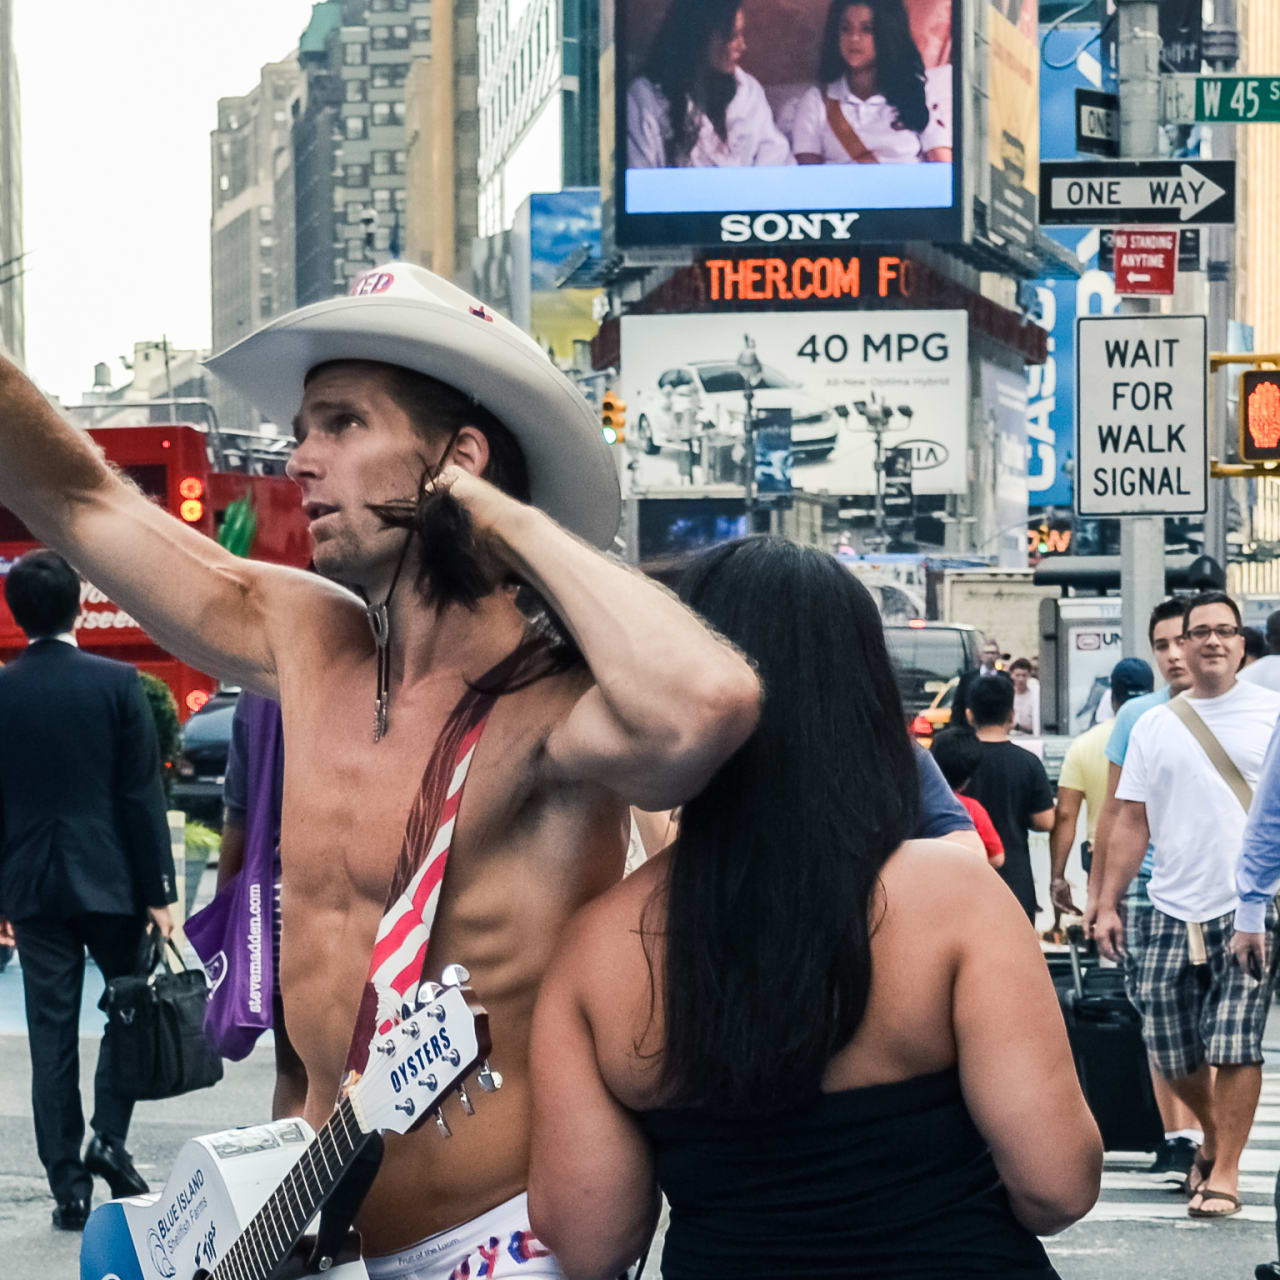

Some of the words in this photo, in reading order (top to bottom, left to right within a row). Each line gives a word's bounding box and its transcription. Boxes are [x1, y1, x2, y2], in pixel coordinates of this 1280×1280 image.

[1202, 80, 1222, 118] W
[1230, 80, 1260, 119] 45
[1066, 181, 1122, 205] ONE
[1149, 181, 1206, 205] WAY
[720, 212, 860, 243] SONY
[1129, 234, 1174, 250] STANDING
[1120, 253, 1165, 269] ANYTIME
[796, 333, 849, 364] 40
[863, 332, 949, 364] MPG
[1104, 338, 1180, 368] WAIT
[1112, 381, 1174, 411] FOR
[1097, 423, 1187, 454] WALK
[1092, 466, 1191, 497] SIGNAL
[247, 883, 262, 1014] stevemadden.com
[389, 1026, 452, 1094] OYSTERS
[157, 1202, 180, 1240] BLUE
[176, 1168, 205, 1214] ISLAND
